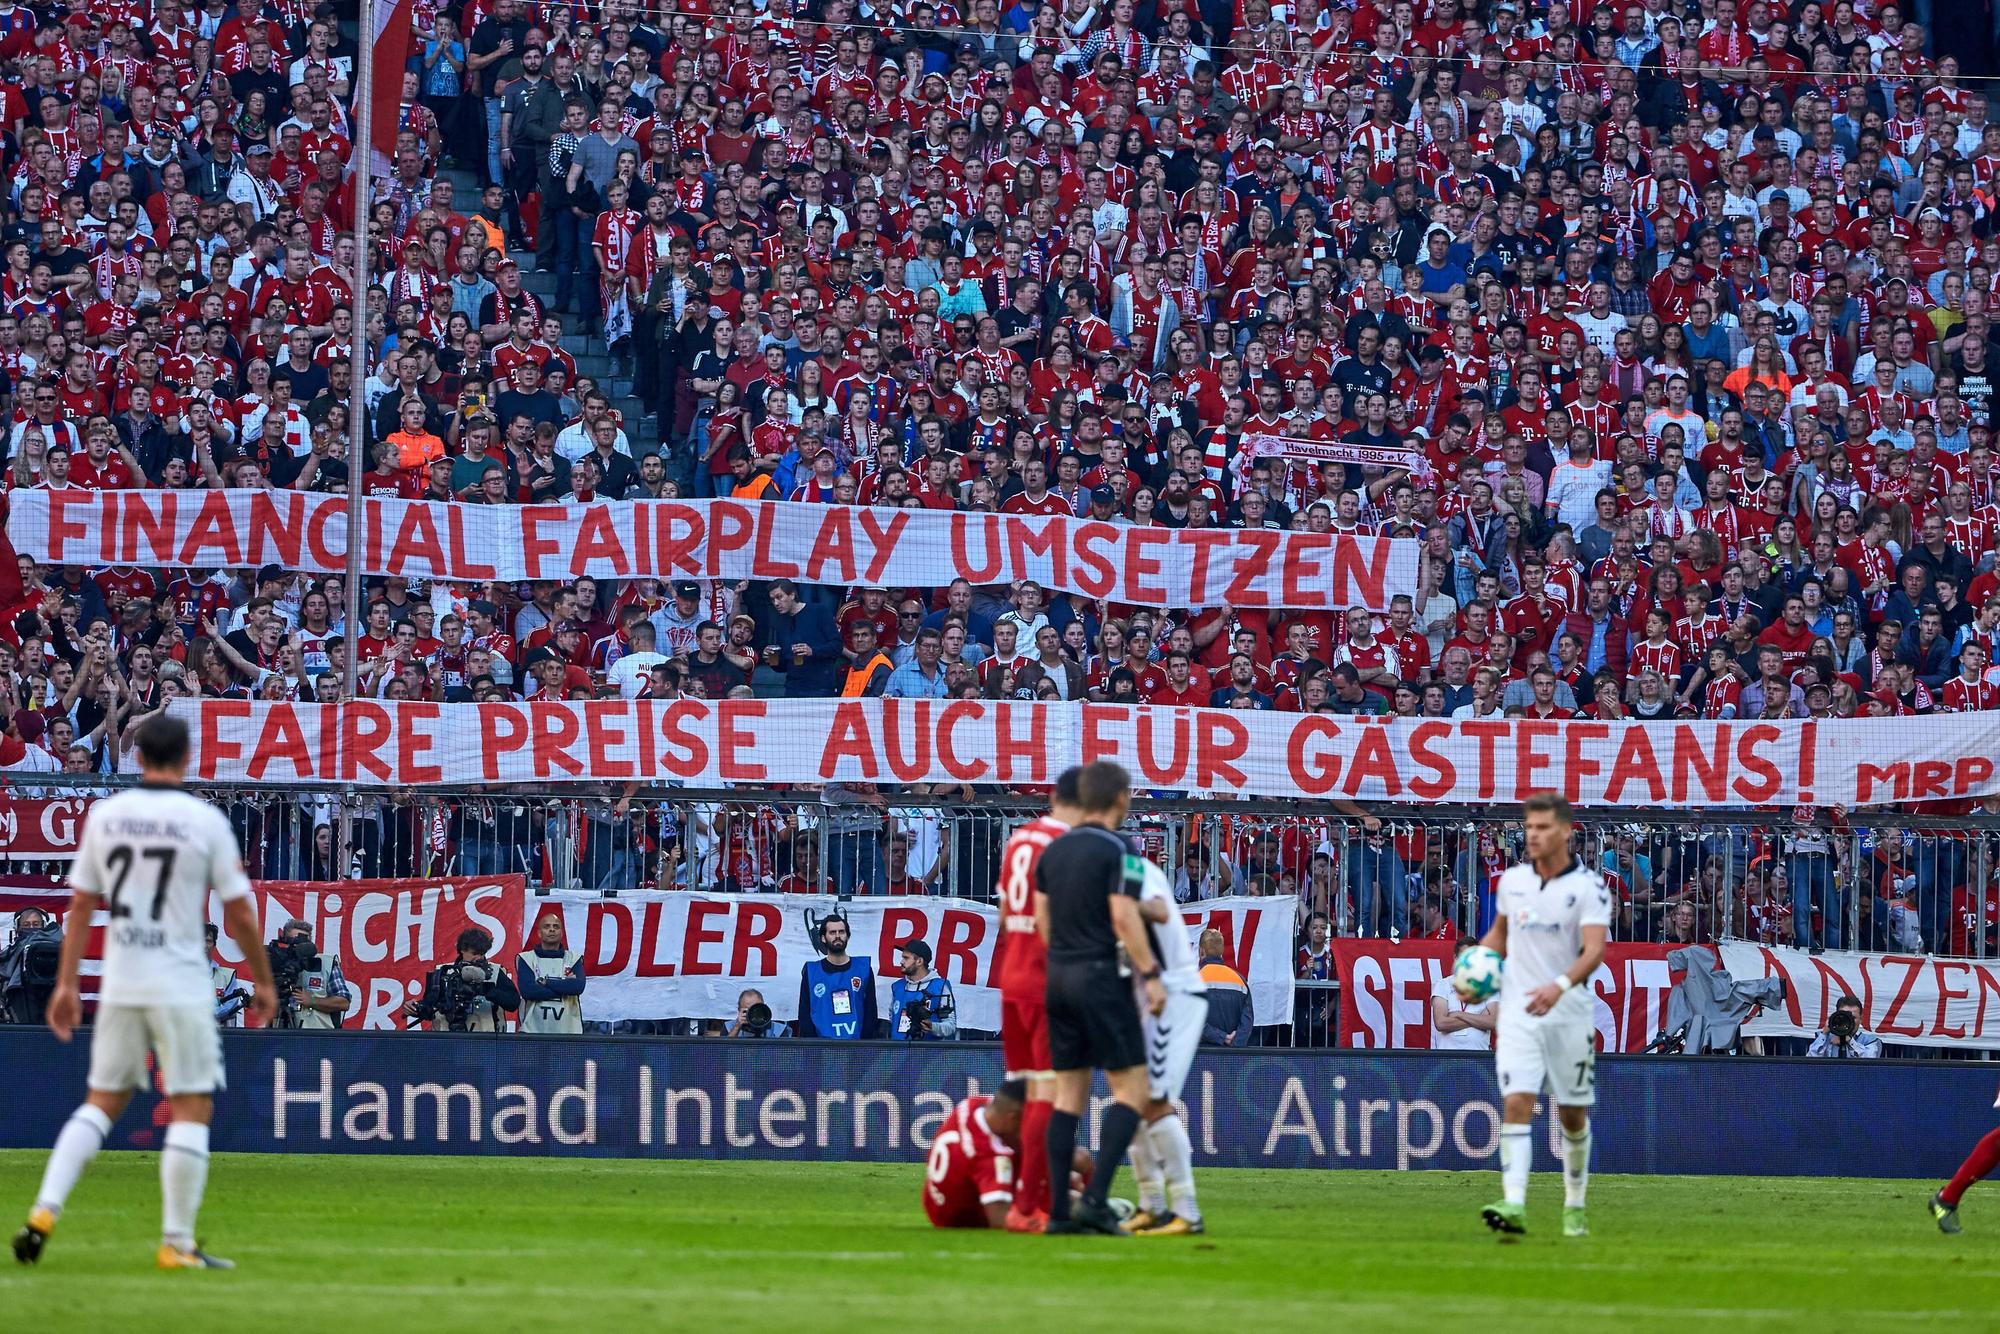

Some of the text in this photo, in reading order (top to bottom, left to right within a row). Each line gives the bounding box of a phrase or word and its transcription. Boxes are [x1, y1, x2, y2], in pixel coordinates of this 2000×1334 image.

[1286, 443, 1354, 459] Havelmacht
[1358, 450, 1384, 461] 1995
[48, 491, 1390, 609] FINANCIAL FAIRPLAY UMSETZEN
[200, 702, 1993, 804] FAIRE PREISE AUCH FÜR GÄSTEFANS! MRP
[106, 844, 177, 921] 27
[1008, 844, 1033, 912] 8
[522, 901, 783, 977] ADLER
[540, 1006, 565, 1021] TV
[832, 1021, 857, 1036] TV
[273, 1057, 597, 1147] Hamad
[1263, 1076, 1564, 1171] Airpot
